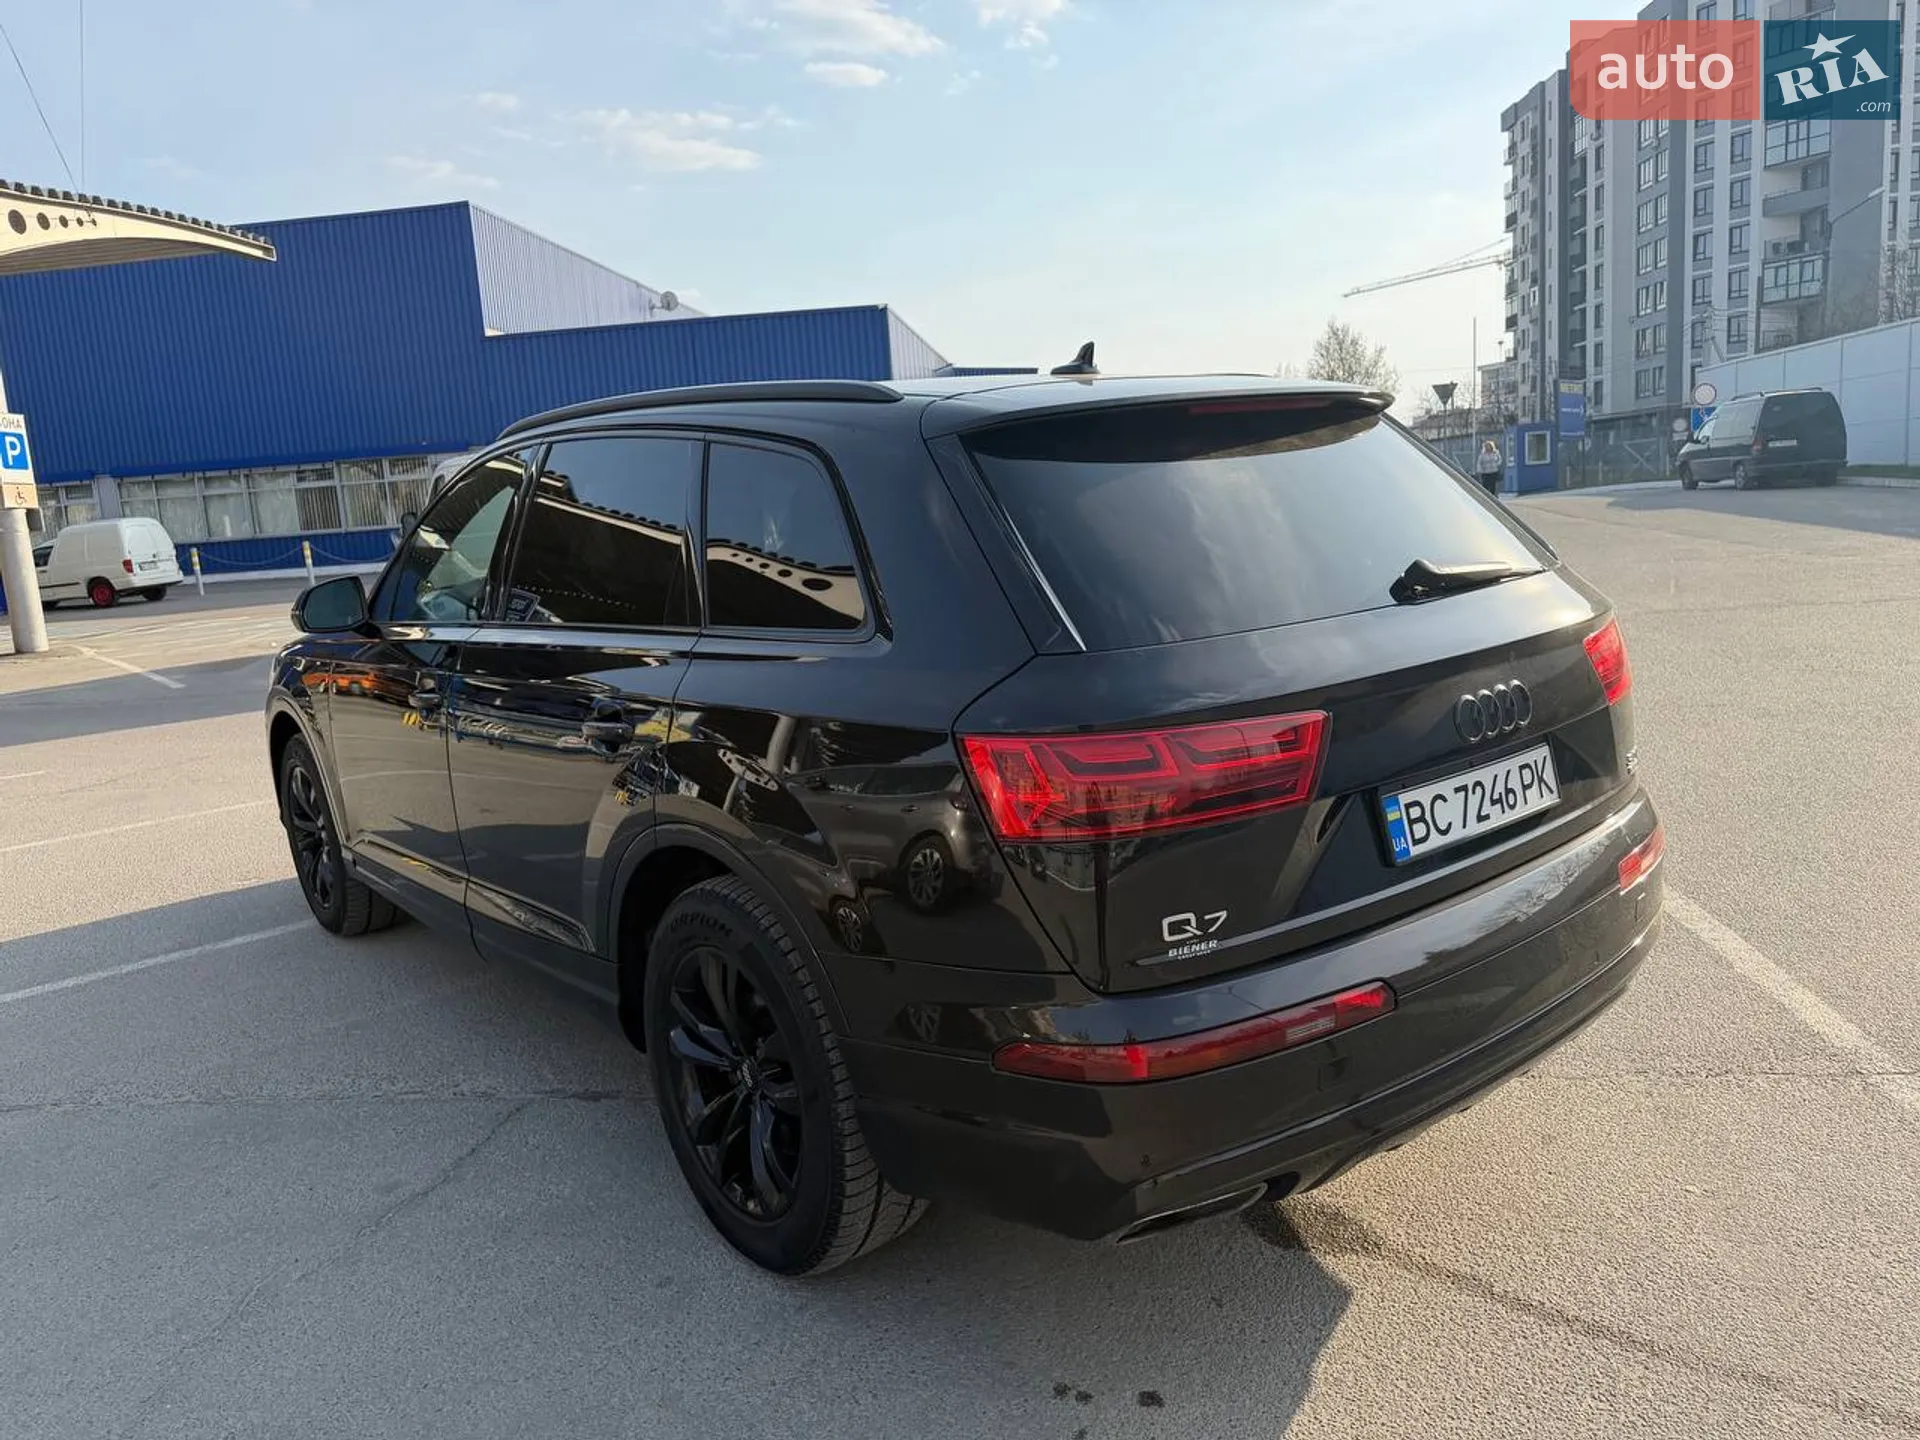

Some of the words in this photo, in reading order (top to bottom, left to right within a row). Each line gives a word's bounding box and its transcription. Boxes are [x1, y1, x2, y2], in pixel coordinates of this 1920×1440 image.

[0, 416, 22, 429] ОНА
[5, 435, 21, 466] P
[1404, 793, 1452, 847] BC
[1453, 769, 1518, 829] 7246
[1518, 755, 1554, 805] PK
[1392, 837, 1408, 851] UA
[1162, 910, 1227, 942] Q7
[1168, 939, 1218, 957] BIENER
